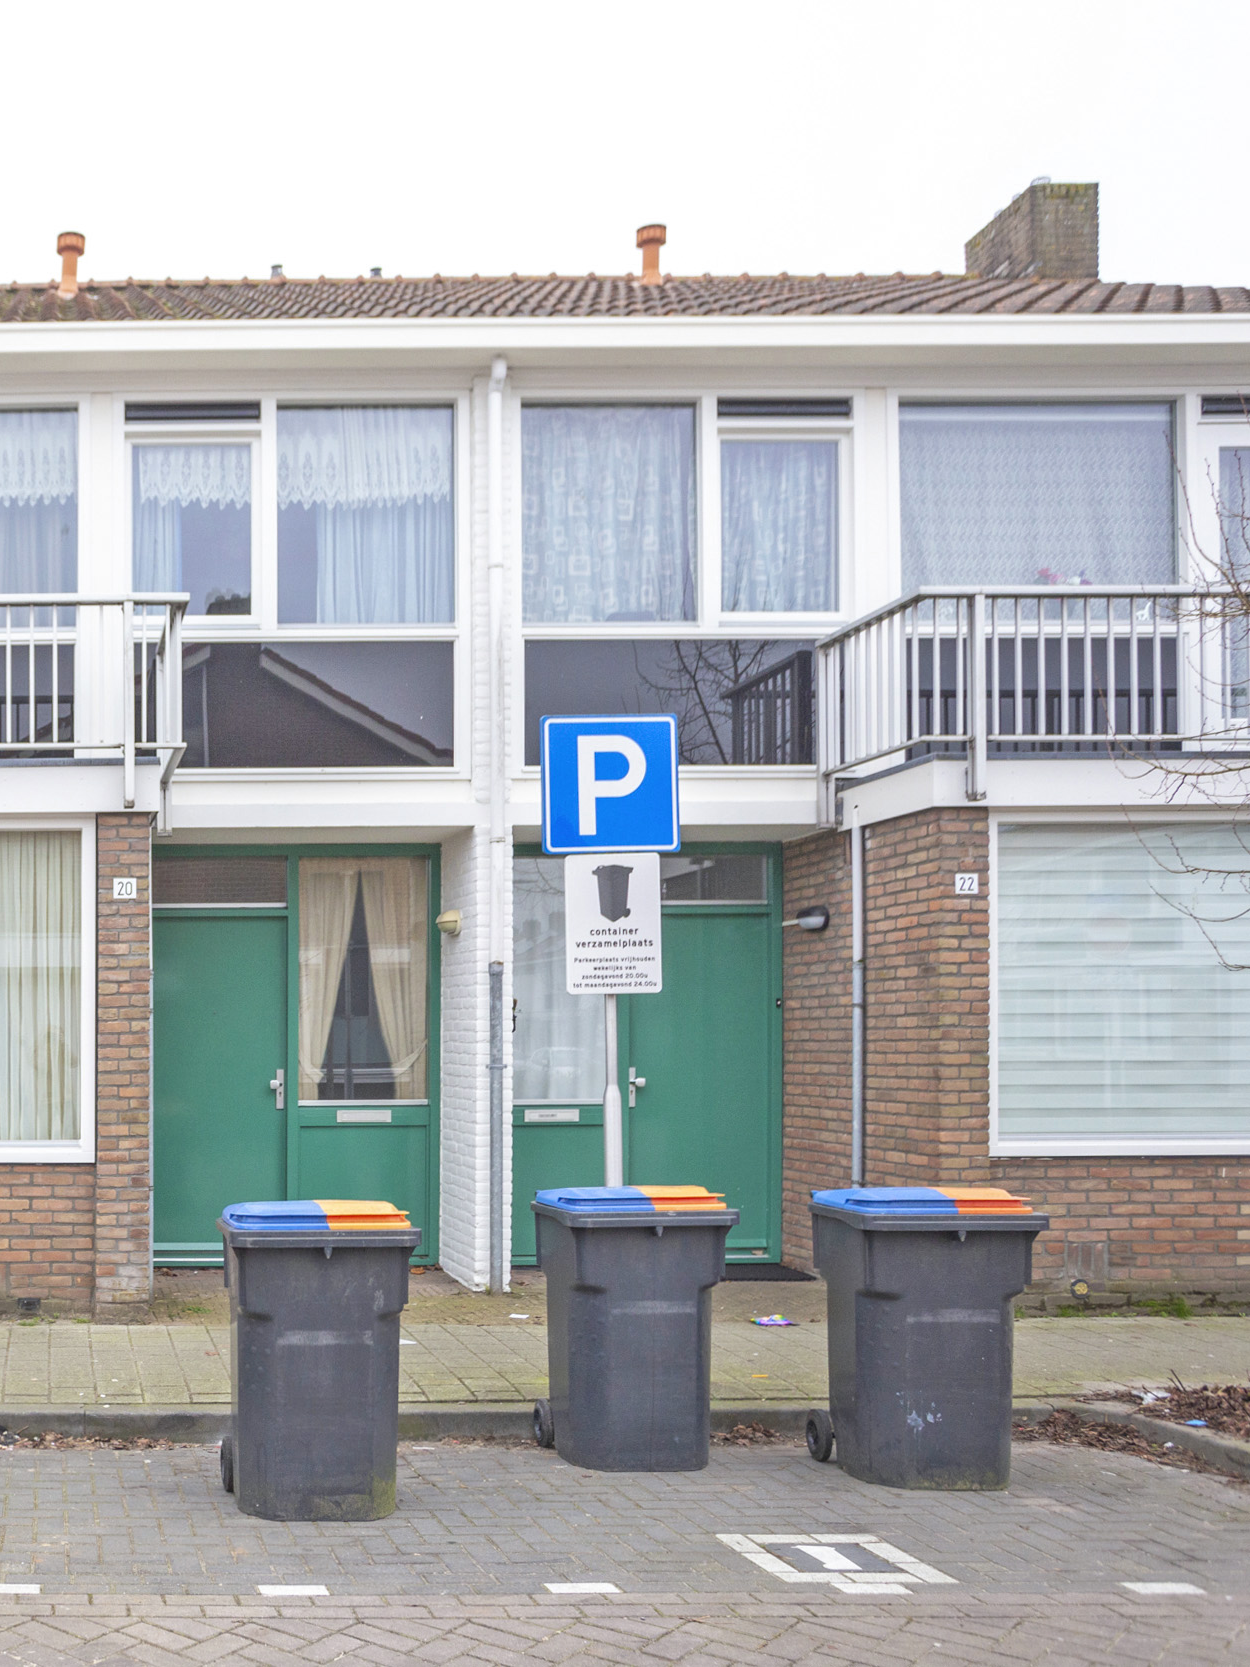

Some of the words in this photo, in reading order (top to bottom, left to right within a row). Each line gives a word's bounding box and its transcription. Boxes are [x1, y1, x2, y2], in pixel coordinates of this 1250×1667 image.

[577, 734, 647, 836] P
[117, 881, 133, 896] 20
[959, 876, 975, 891] 22
[589, 927, 639, 936] container
[575, 938, 654, 949] verzamelplaats
[620, 955, 656, 963] vrijhouden
